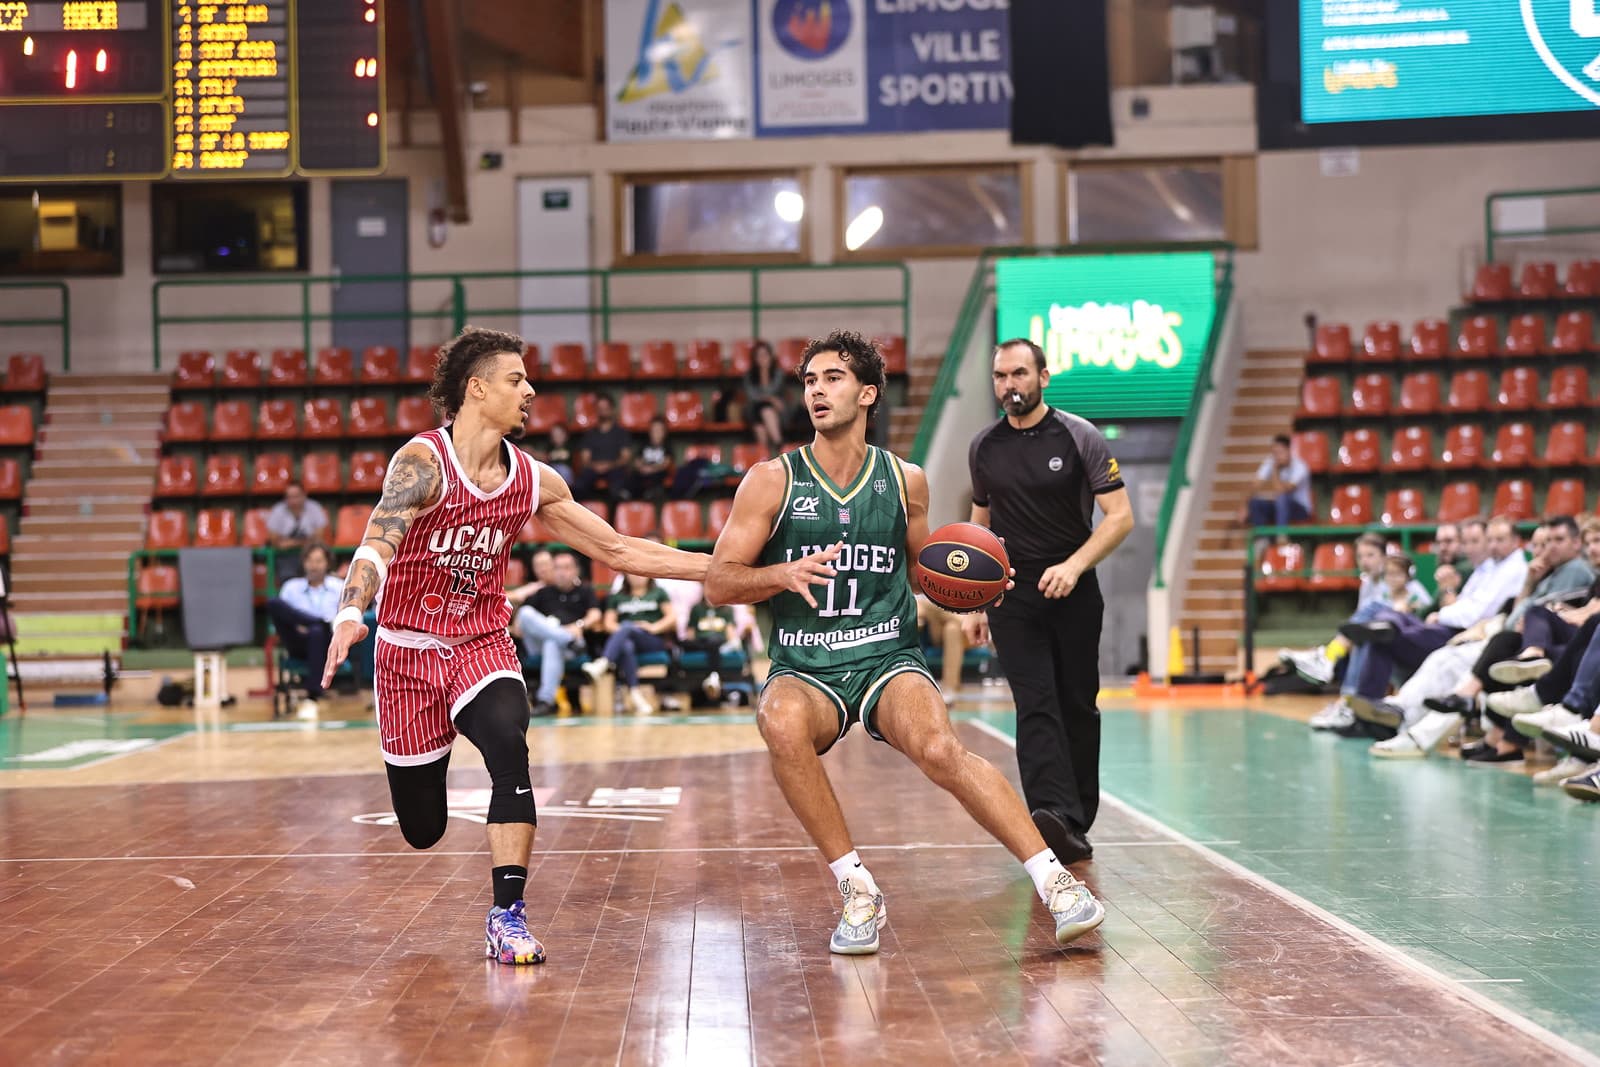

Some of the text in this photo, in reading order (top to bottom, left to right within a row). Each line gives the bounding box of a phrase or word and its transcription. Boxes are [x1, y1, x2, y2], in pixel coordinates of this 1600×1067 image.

[911, 30, 1001, 63] VILLE
[429, 525, 509, 555] UCAM
[436, 554, 493, 571] MURCIA
[450, 568, 477, 597] 12
[818, 578, 862, 617] 11
[778, 616, 900, 649] Intermarché
